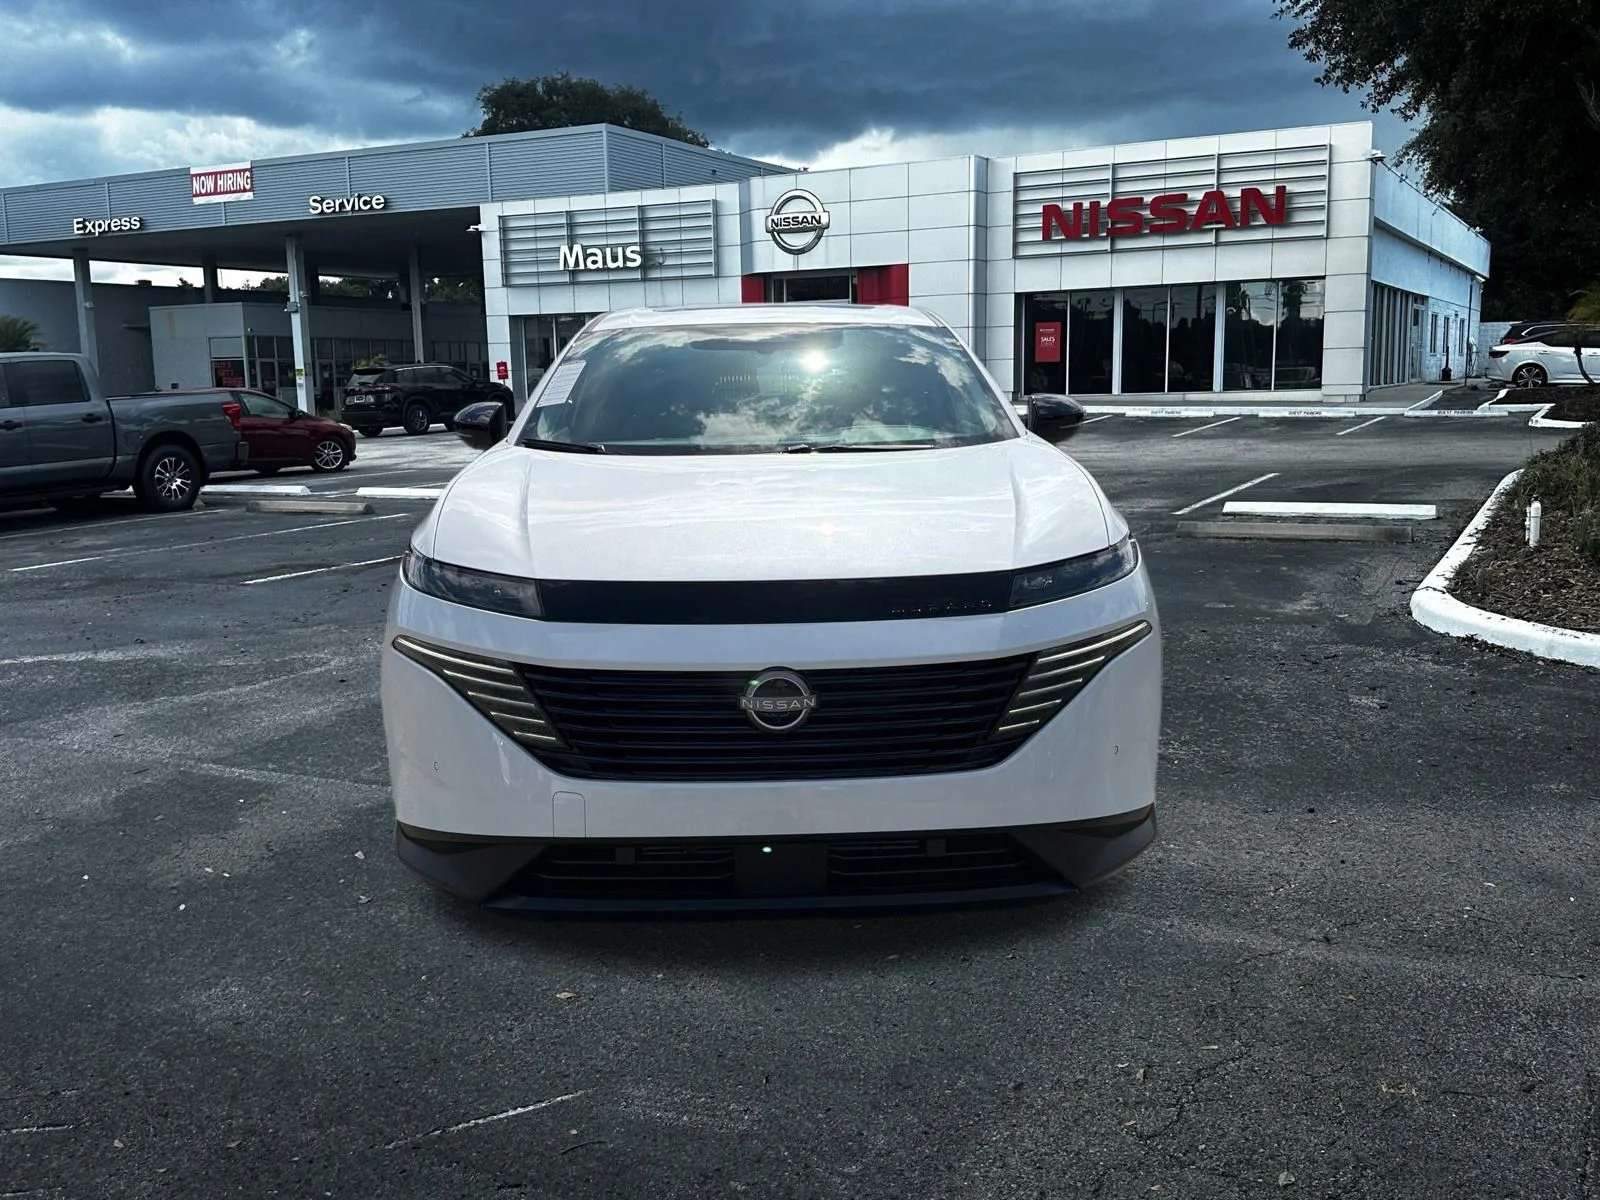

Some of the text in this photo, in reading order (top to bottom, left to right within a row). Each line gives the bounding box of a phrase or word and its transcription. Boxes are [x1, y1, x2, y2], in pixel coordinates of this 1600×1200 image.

[192, 171, 251, 195] NOW HIRING
[309, 193, 385, 214] Service
[1042, 185, 1287, 242] NISSAN
[73, 216, 141, 237] Express
[770, 214, 823, 229] NISSAN
[559, 243, 642, 271] Maus
[742, 698, 815, 710] NISSAN
